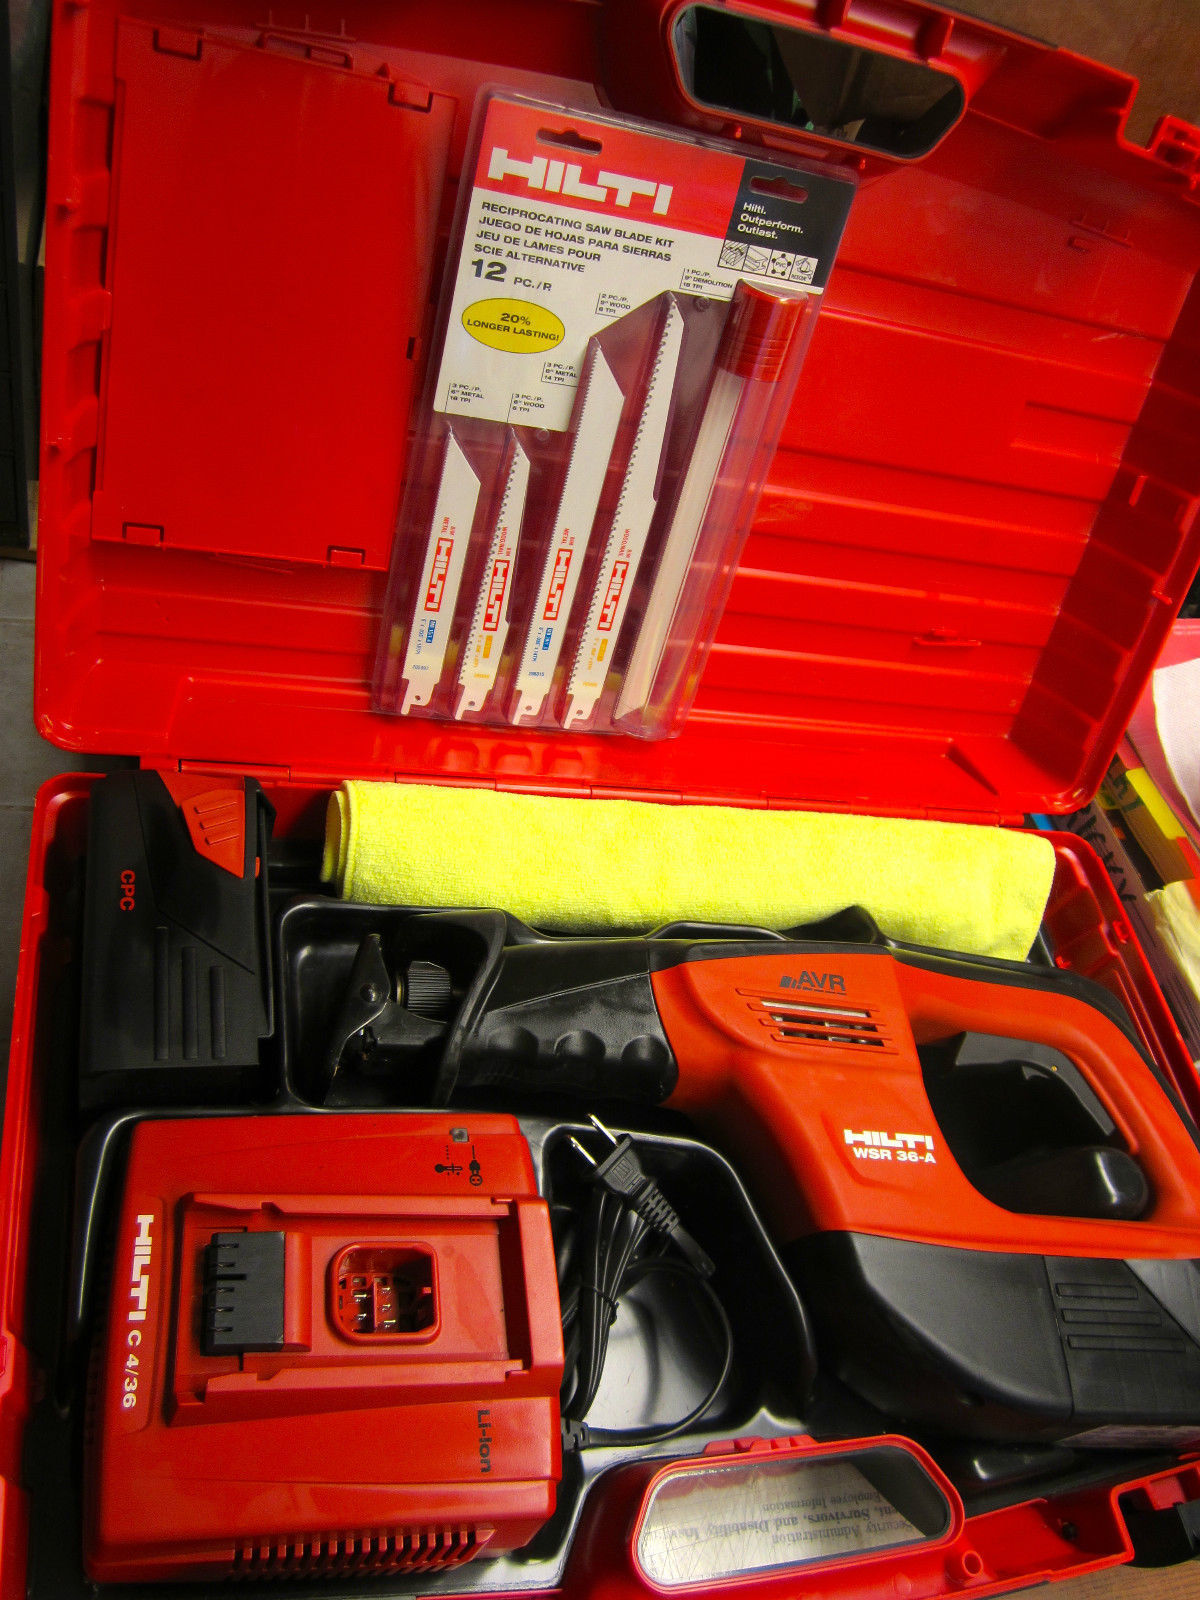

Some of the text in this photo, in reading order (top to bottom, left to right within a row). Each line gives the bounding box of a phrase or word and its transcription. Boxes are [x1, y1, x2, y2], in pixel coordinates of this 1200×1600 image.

[488, 147, 673, 215] HILTI
[743, 202, 767, 214] Hilti.
[481, 201, 674, 248] RECIPROCATING SAW BLADE KIT
[737, 223, 778, 240] Outlast.
[740, 213, 804, 234] Outperform.
[476, 230, 601, 261] JEU DE LAMES POUR
[479, 216, 672, 261] JUEGO DE HOJAS PARA SIERRAS
[474, 243, 585, 273] SCIE ALTERNATIVE
[471, 258, 507, 283] 12
[693, 276, 733, 289] DEMOLITION
[610, 302, 631, 310] WOOD
[467, 318, 559, 342] LONGER LASTING!
[501, 312, 531, 326] 20%
[555, 370, 578, 379] METAL
[461, 391, 485, 399] METAL
[523, 401, 545, 409] WOOD
[425, 539, 452, 611] HILTI
[544, 550, 572, 619] HILTI
[484, 560, 508, 630] HILTI
[598, 562, 628, 630] HILTI
[120, 869, 136, 911] CPC
[799, 970, 846, 991] AVR
[844, 1129, 934, 1150] HILTI
[852, 1147, 936, 1164] WSR 36-A
[128, 1215, 154, 1321] HILTI
[122, 1329, 142, 1408] C 4/36
[477, 1410, 492, 1473] Li-Ion
[762, 1490, 882, 1513] Employee Information
[775, 1514, 799, 1528] and
[803, 1508, 870, 1524] Survivors,
[705, 1518, 769, 1538] Disability
[771, 1523, 861, 1546] Administration
